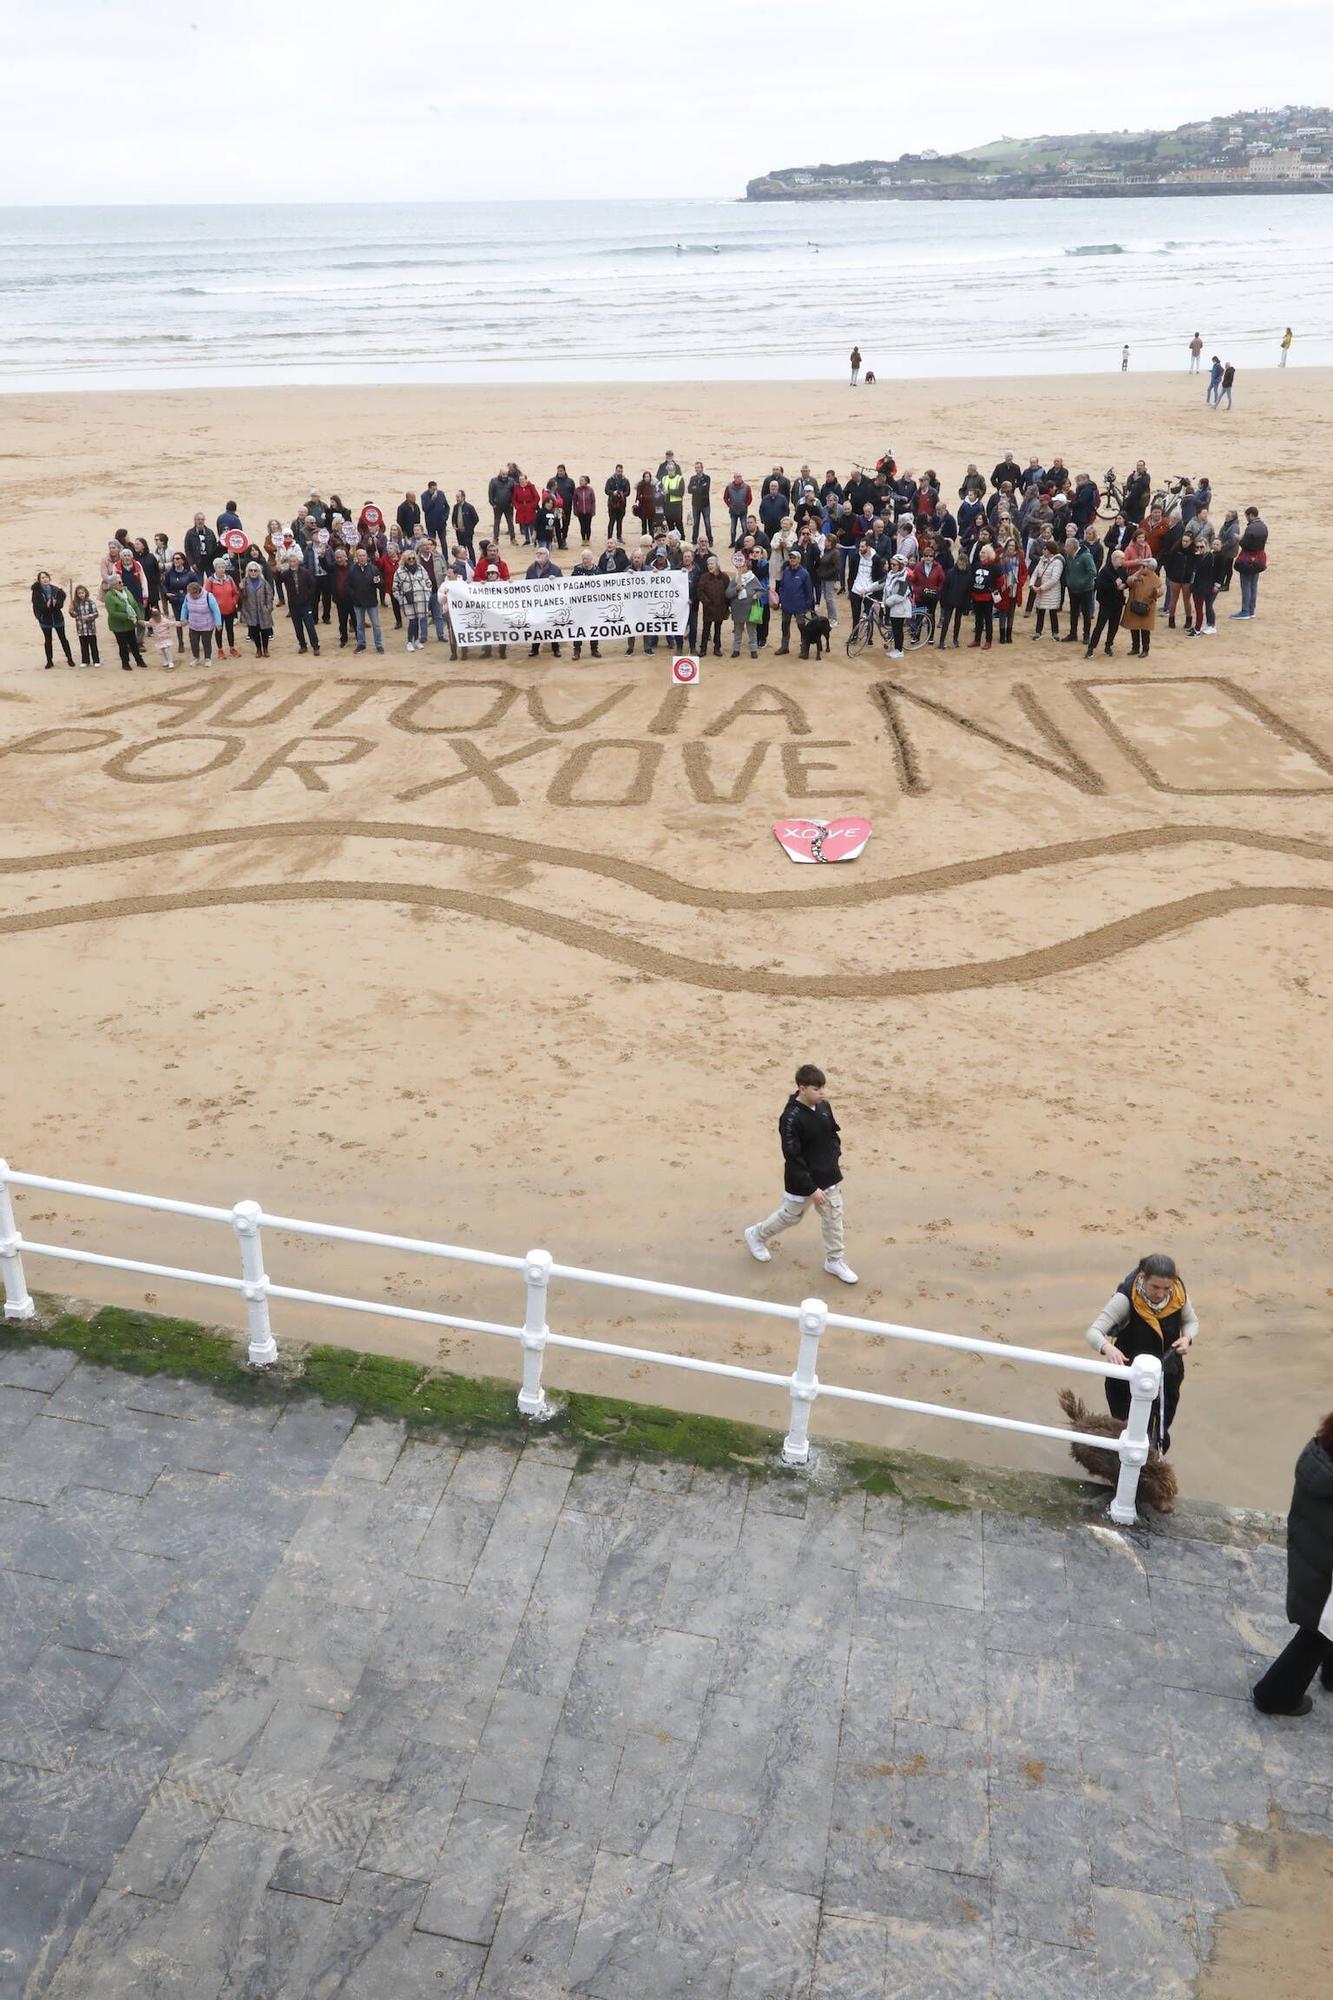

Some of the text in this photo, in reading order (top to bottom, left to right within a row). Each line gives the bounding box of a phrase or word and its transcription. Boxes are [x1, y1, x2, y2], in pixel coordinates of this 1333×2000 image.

[503, 585, 531, 594] SOMOS
[563, 580, 601, 590] PAGAMOS
[650, 576, 671, 584] PERO
[451, 600, 463, 609] NO
[465, 599, 519, 609] APARECEMOS
[521, 599, 532, 608] EN
[569, 593, 621, 604] INVERSIONES
[623, 592, 631, 600] NI
[632, 590, 680, 599] PROYECTOS
[457, 621, 678, 643] RESPETO PARA LA ZONA OESTE
[81, 676, 1333, 798] AUTOVIA NO
[0, 727, 866, 807] POR XOVE
